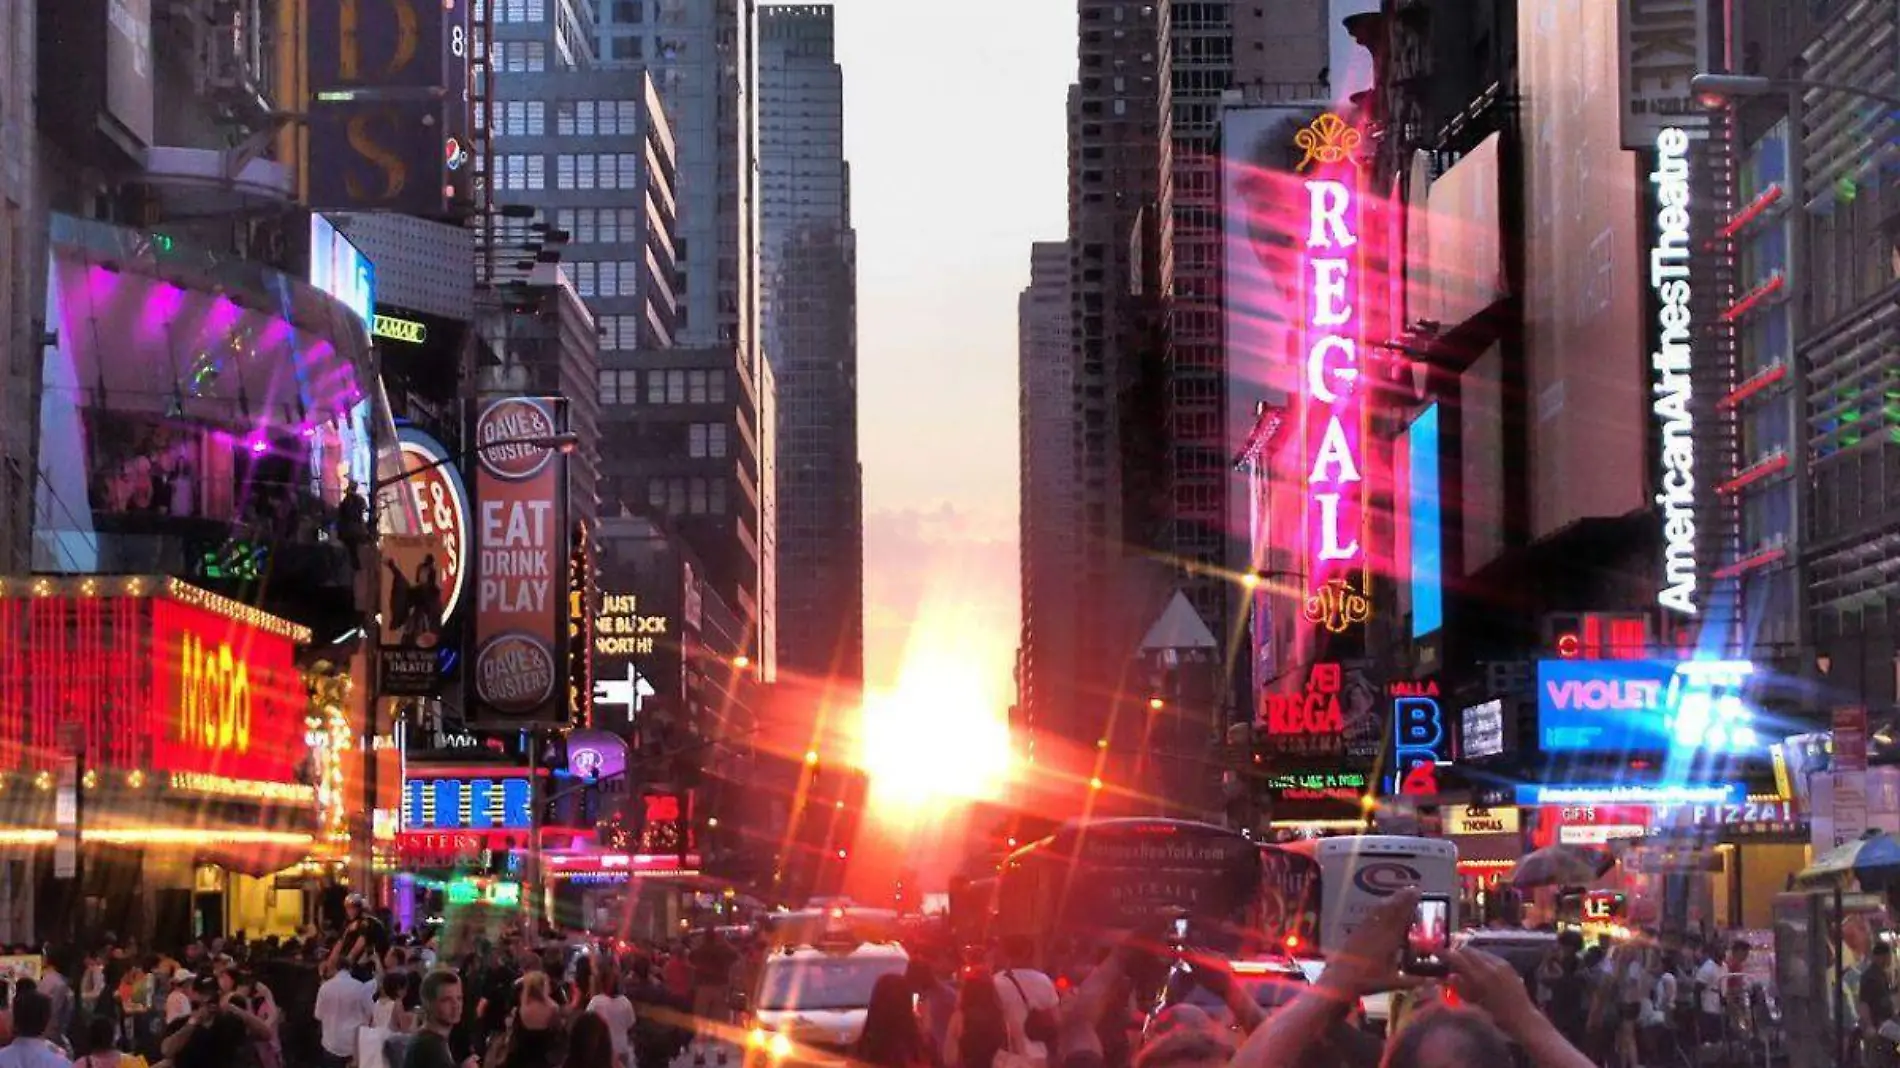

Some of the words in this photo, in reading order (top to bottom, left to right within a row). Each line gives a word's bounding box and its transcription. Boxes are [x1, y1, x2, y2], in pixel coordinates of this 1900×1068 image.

[1304, 179, 1358, 562] REGAL
[484, 411, 530, 444] DAVE
[530, 411, 546, 432] &
[482, 501, 550, 547] EAT
[481, 550, 550, 577] DRINK
[479, 577, 549, 613] PLAY
[601, 591, 636, 615] JUST
[484, 650, 531, 679] DAVE
[1546, 679, 1662, 710] VIOLET
[1463, 819, 1504, 831] THOMAS
[1562, 805, 1595, 821] GIFTS
